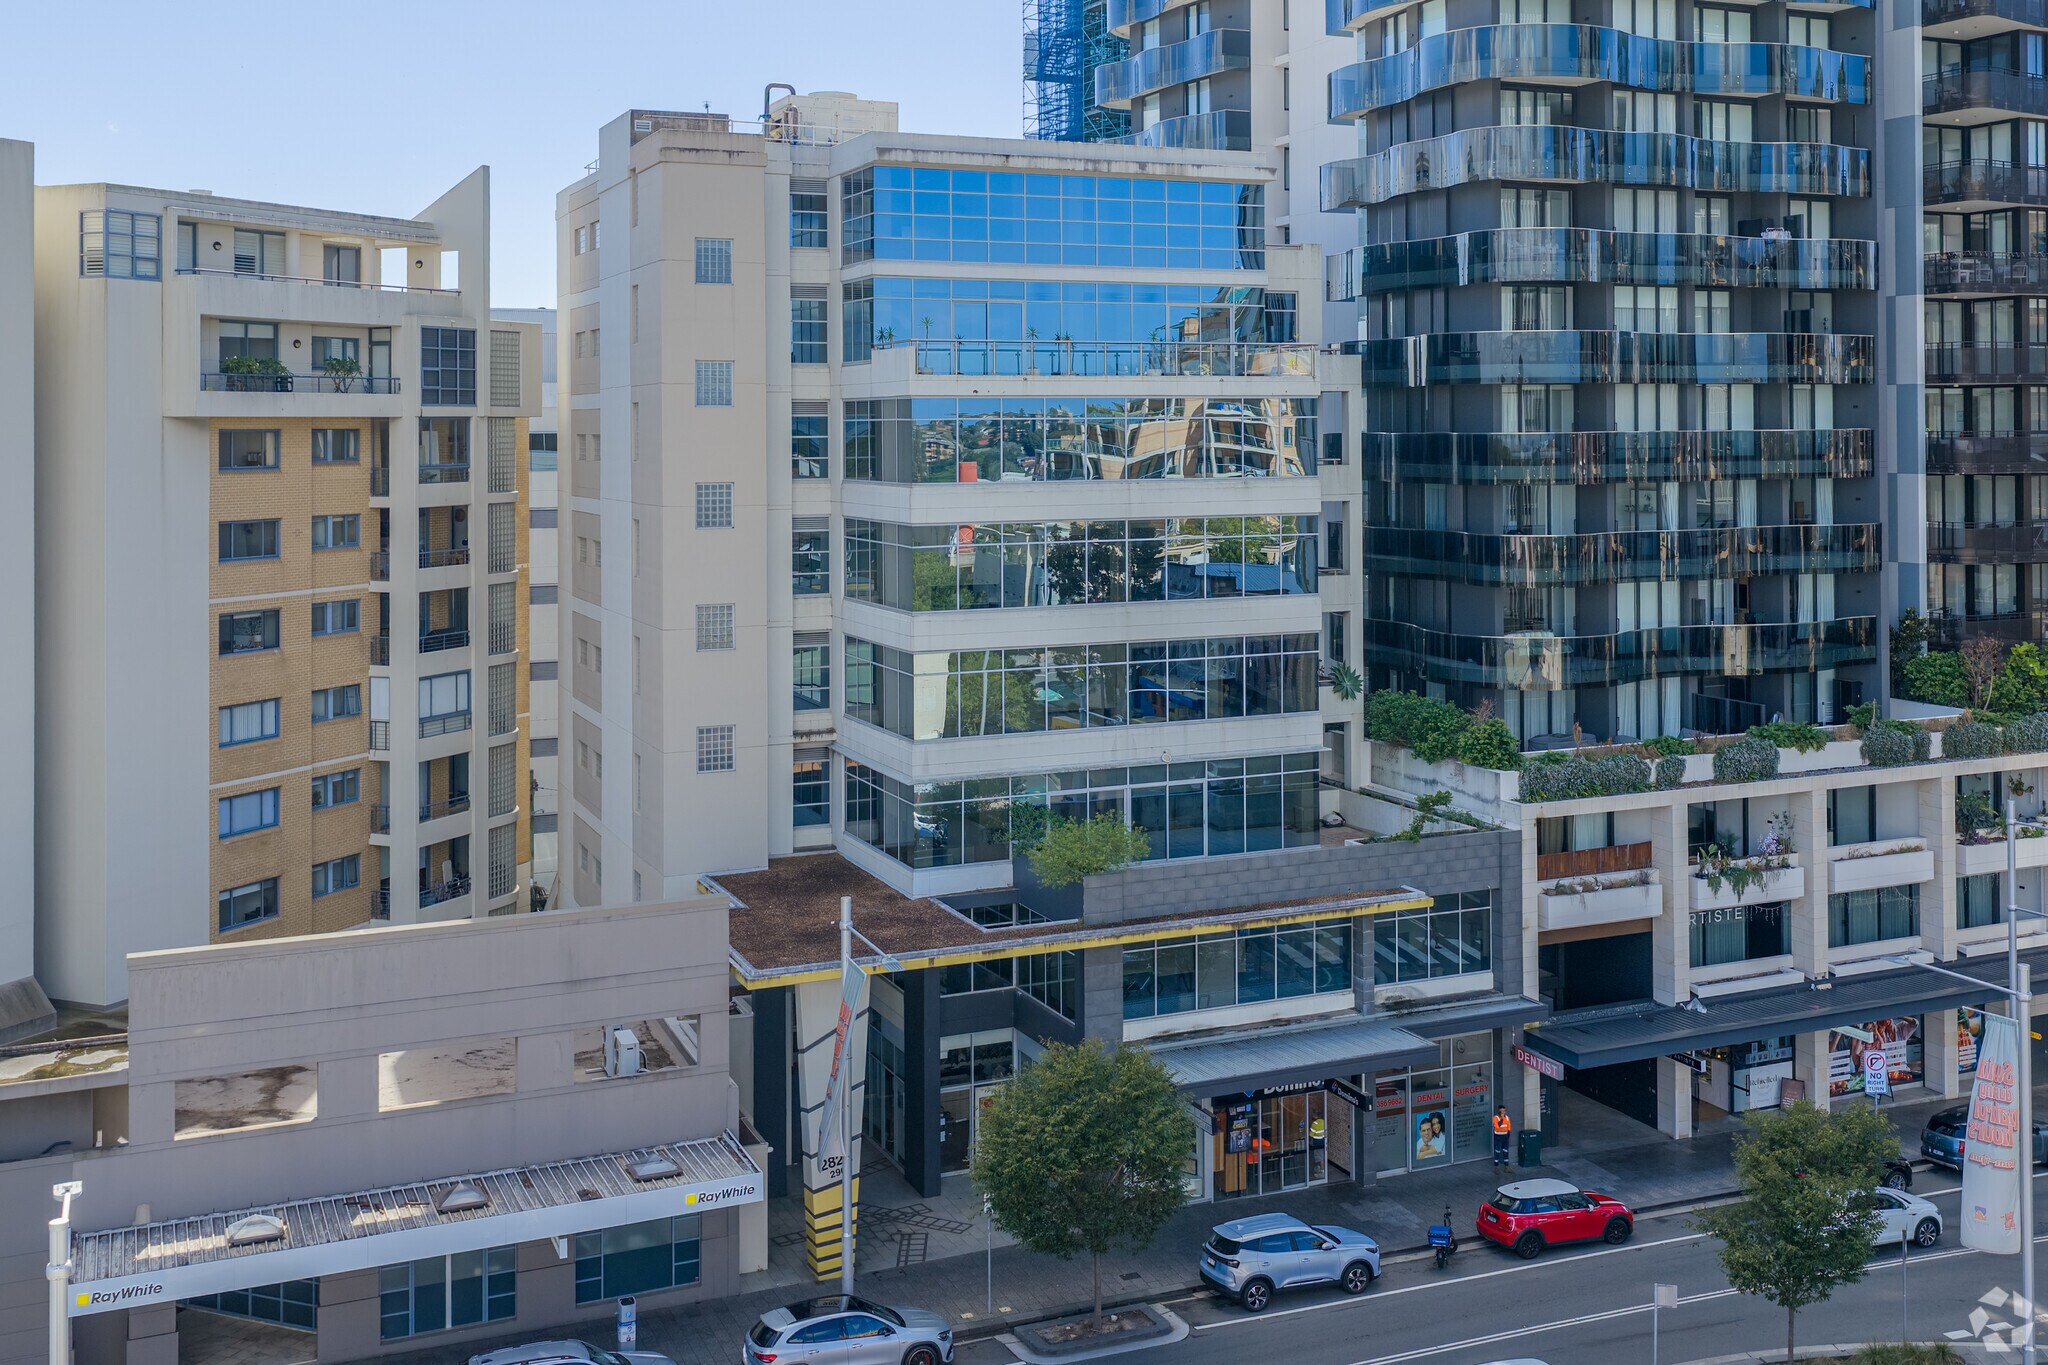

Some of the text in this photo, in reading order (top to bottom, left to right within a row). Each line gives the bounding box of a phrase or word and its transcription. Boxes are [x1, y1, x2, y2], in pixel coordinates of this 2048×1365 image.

[1689, 907, 1743, 926] RTISTE
[1517, 1049, 1558, 1077] DENTIST
[1869, 1072, 1882, 1080] NO
[1337, 1087, 1359, 1106] Domino's
[1417, 1092, 1444, 1103] DENTAL
[1455, 1084, 1489, 1097] SURGERY
[821, 1156, 843, 1172] 282
[829, 1168, 843, 1179] 29
